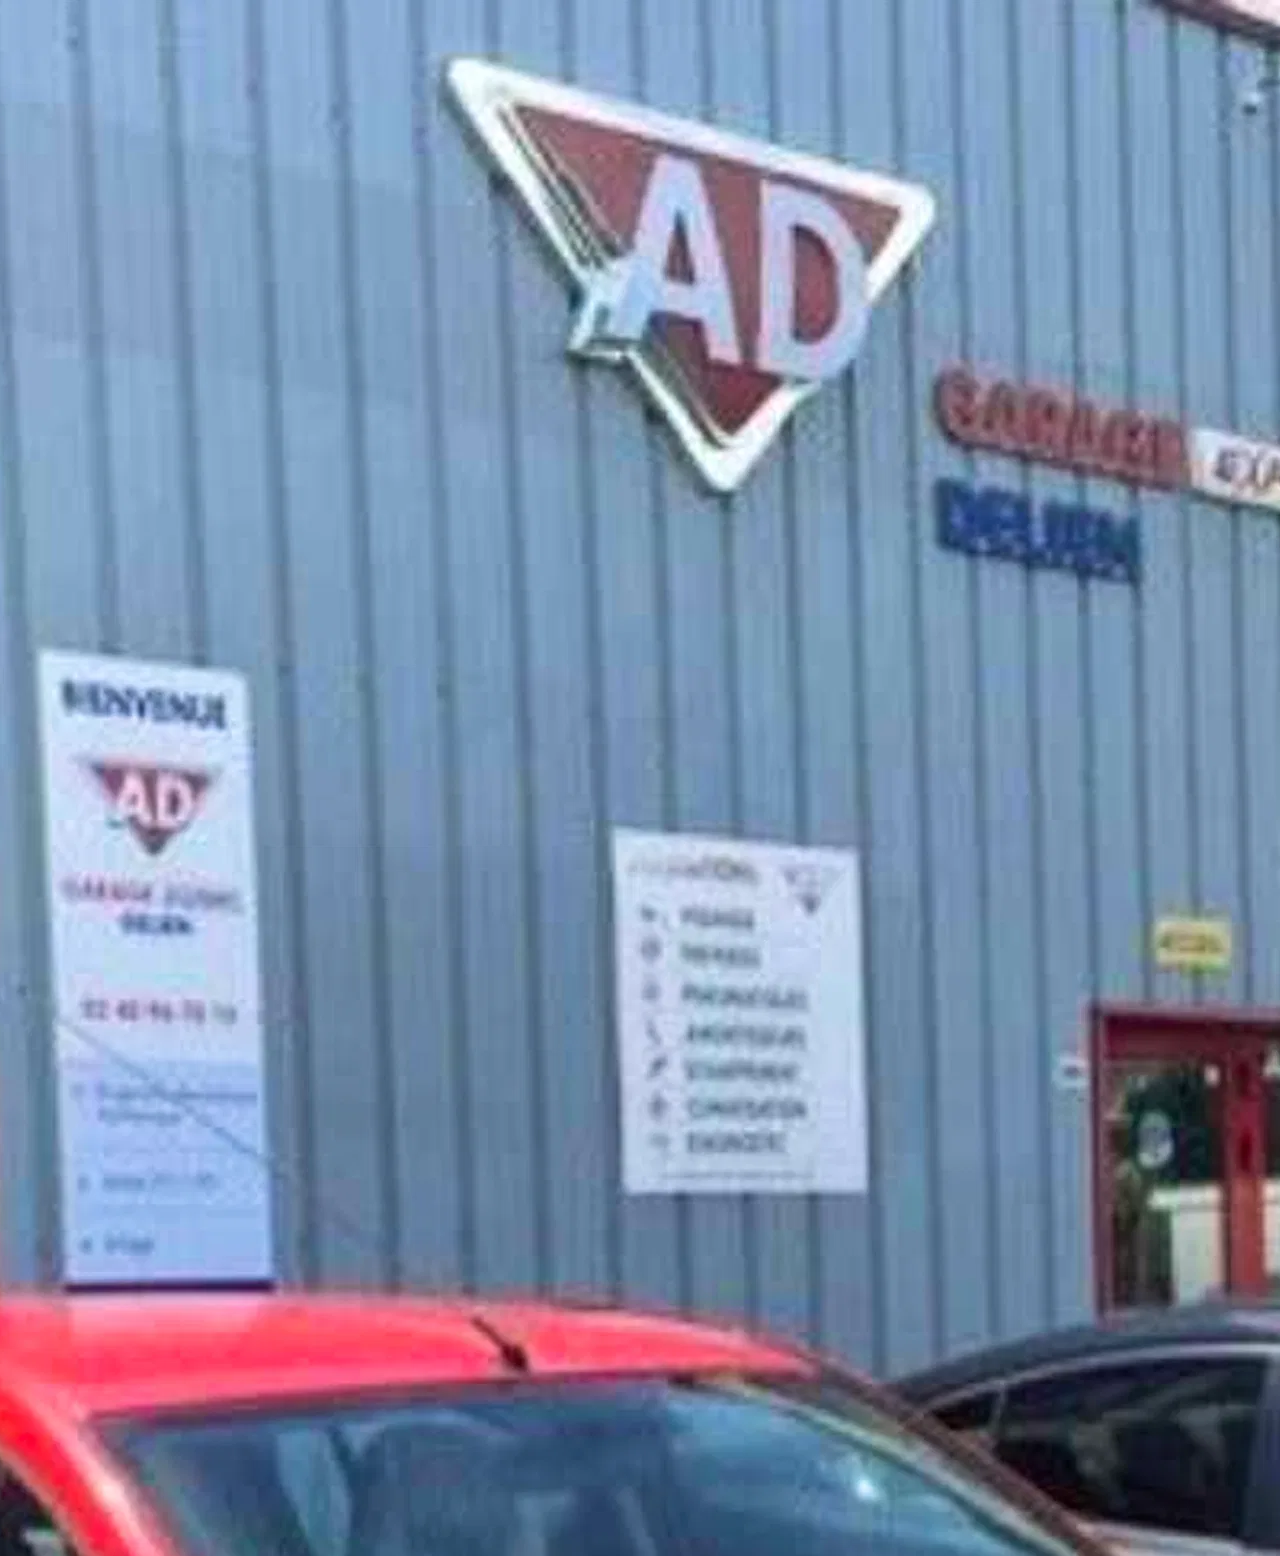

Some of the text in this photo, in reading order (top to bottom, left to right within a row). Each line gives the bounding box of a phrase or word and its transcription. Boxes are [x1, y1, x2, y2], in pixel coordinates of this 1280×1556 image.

[604, 152, 872, 380] AD
[932, 366, 1182, 490] GARAGE
[60, 680, 227, 731] BIENVENUE
[116, 770, 200, 830] AD
